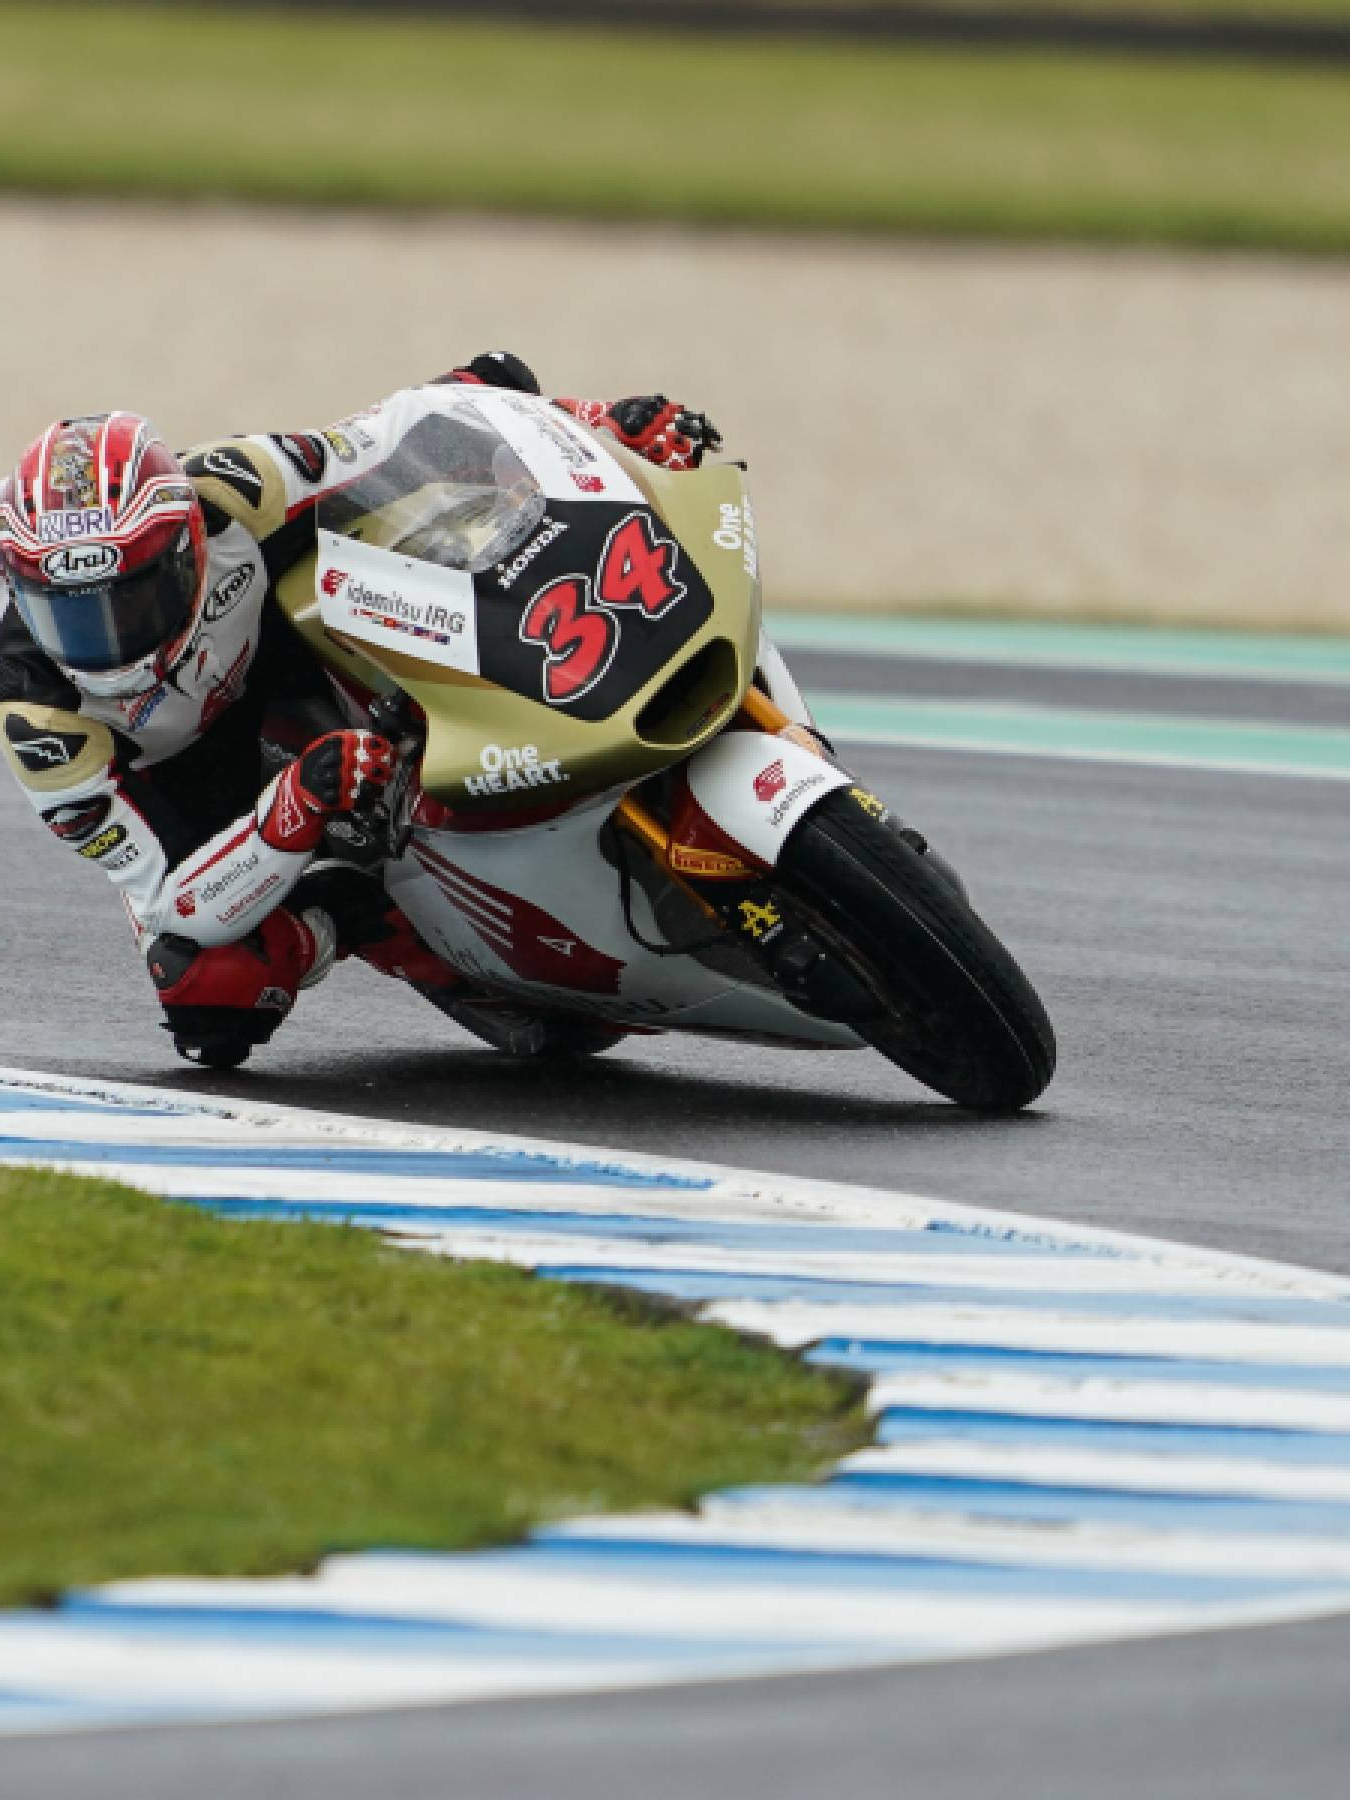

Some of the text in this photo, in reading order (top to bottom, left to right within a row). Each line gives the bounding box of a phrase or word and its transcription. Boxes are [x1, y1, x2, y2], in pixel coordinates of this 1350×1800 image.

[713, 503, 742, 550] One
[53, 548, 109, 572] Arai
[498, 516, 569, 589] HONDA
[212, 566, 252, 612] Arai
[346, 579, 466, 635] idemitsu IRG
[519, 511, 687, 702] 34
[463, 757, 571, 796] HEART.
[480, 743, 539, 773] One
[766, 771, 827, 828] idemitsu
[200, 852, 262, 905] idemitsu
